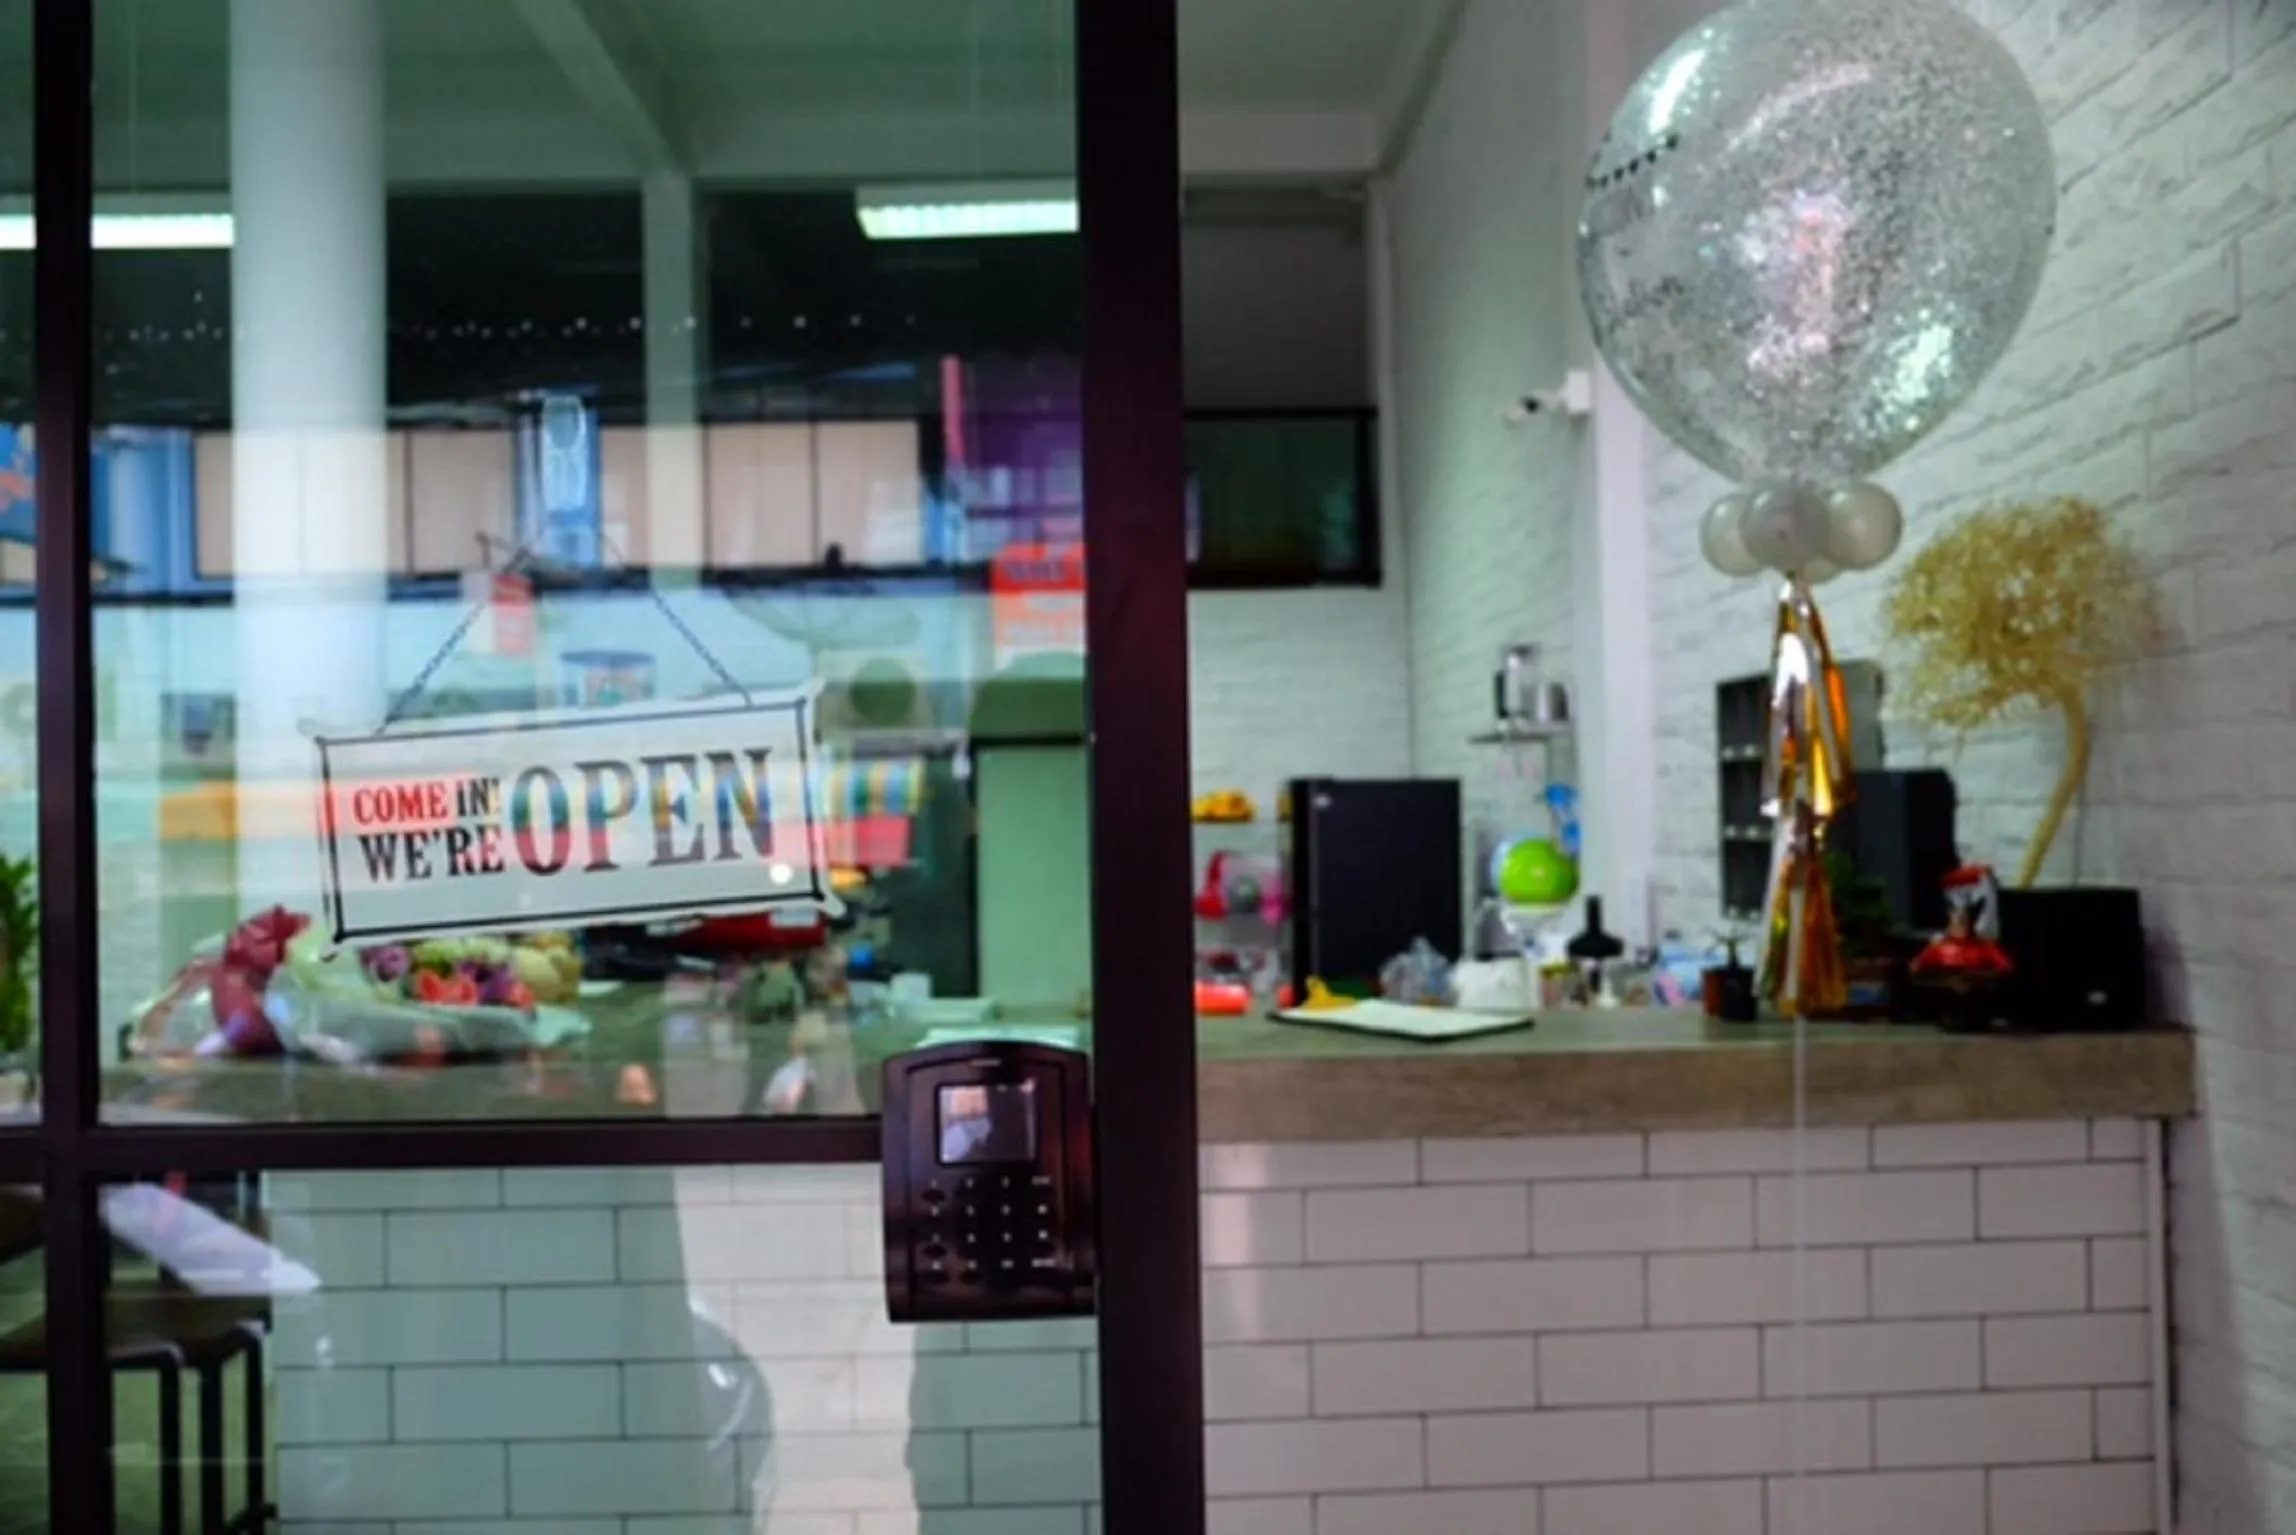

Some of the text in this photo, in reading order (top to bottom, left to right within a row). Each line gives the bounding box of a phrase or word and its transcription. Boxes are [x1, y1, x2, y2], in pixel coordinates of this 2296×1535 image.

[353, 782, 448, 825] COME
[358, 748, 775, 882] WE'RE OPEN
